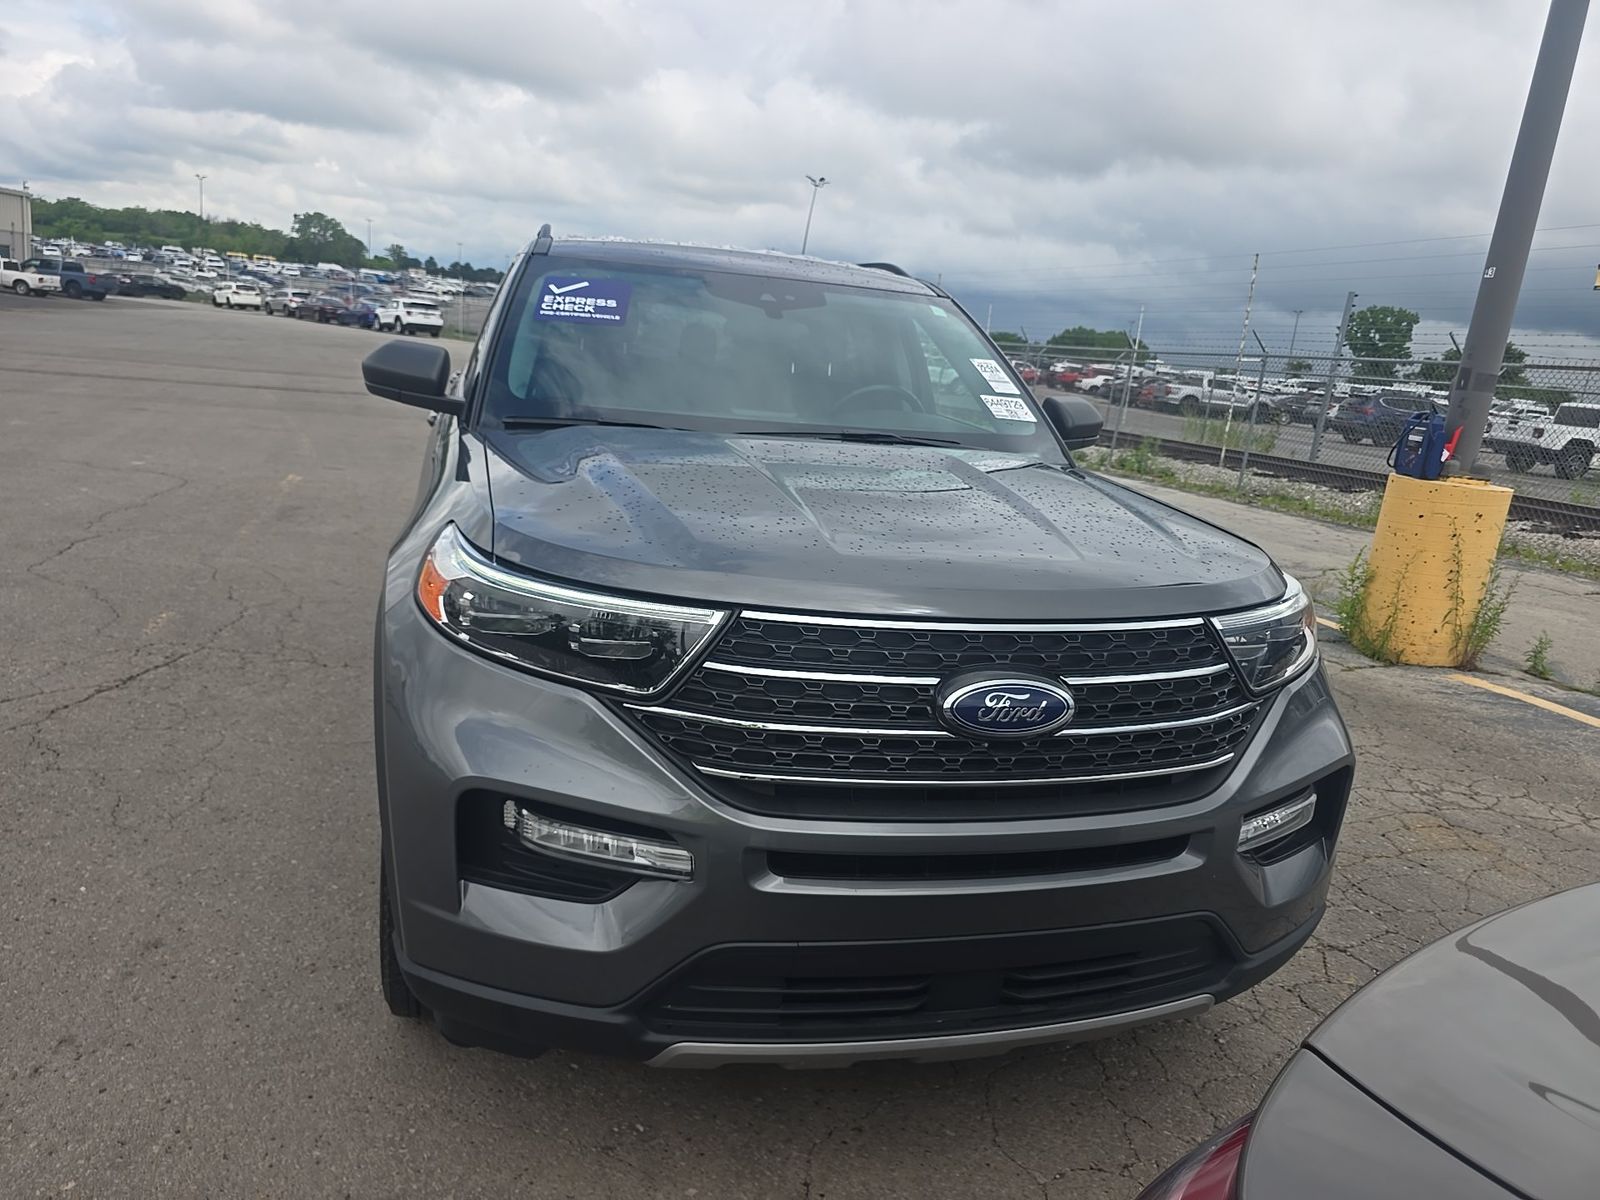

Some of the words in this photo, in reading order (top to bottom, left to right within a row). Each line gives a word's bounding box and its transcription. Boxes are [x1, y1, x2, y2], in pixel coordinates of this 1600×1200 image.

[544, 295, 616, 307] EXPRESS
[541, 303, 594, 312] CHECK
[977, 692, 1048, 722] Ford
